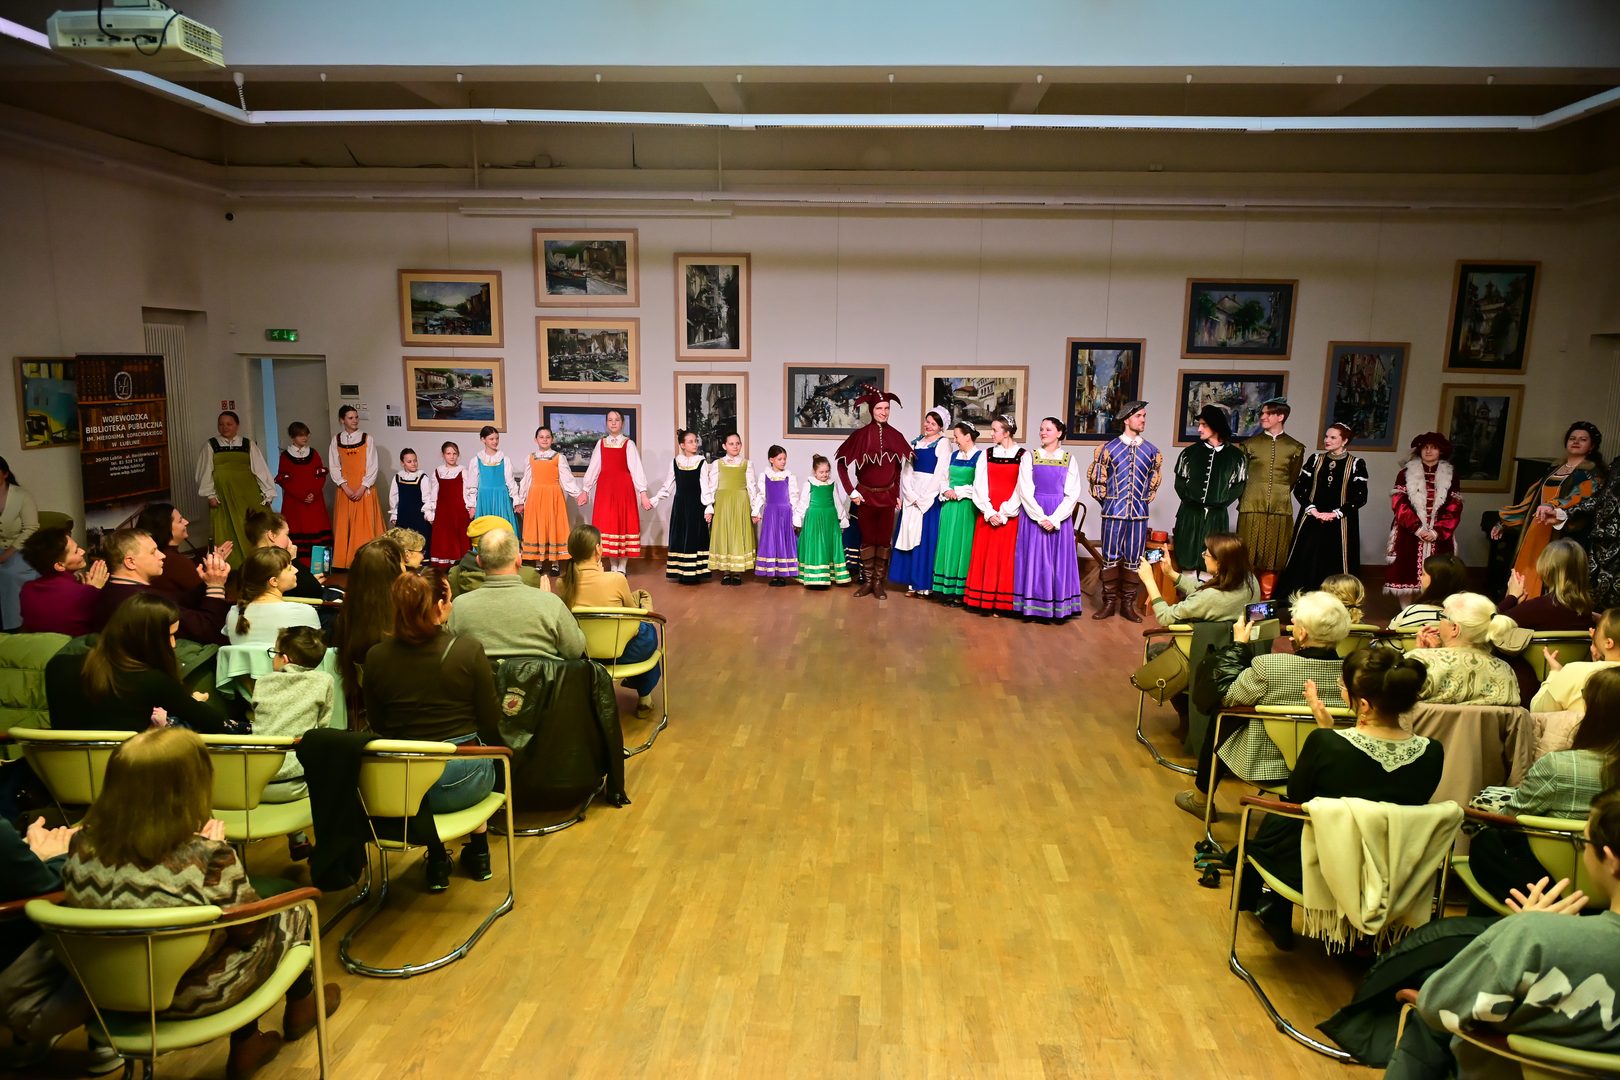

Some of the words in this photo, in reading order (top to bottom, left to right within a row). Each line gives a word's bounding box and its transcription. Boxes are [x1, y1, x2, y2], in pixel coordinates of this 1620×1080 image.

[85, 424, 126, 434] BIBLIOTEKA
[128, 421, 163, 431] PUBLICZNA
[96, 433, 125, 441] HIERONIMA
